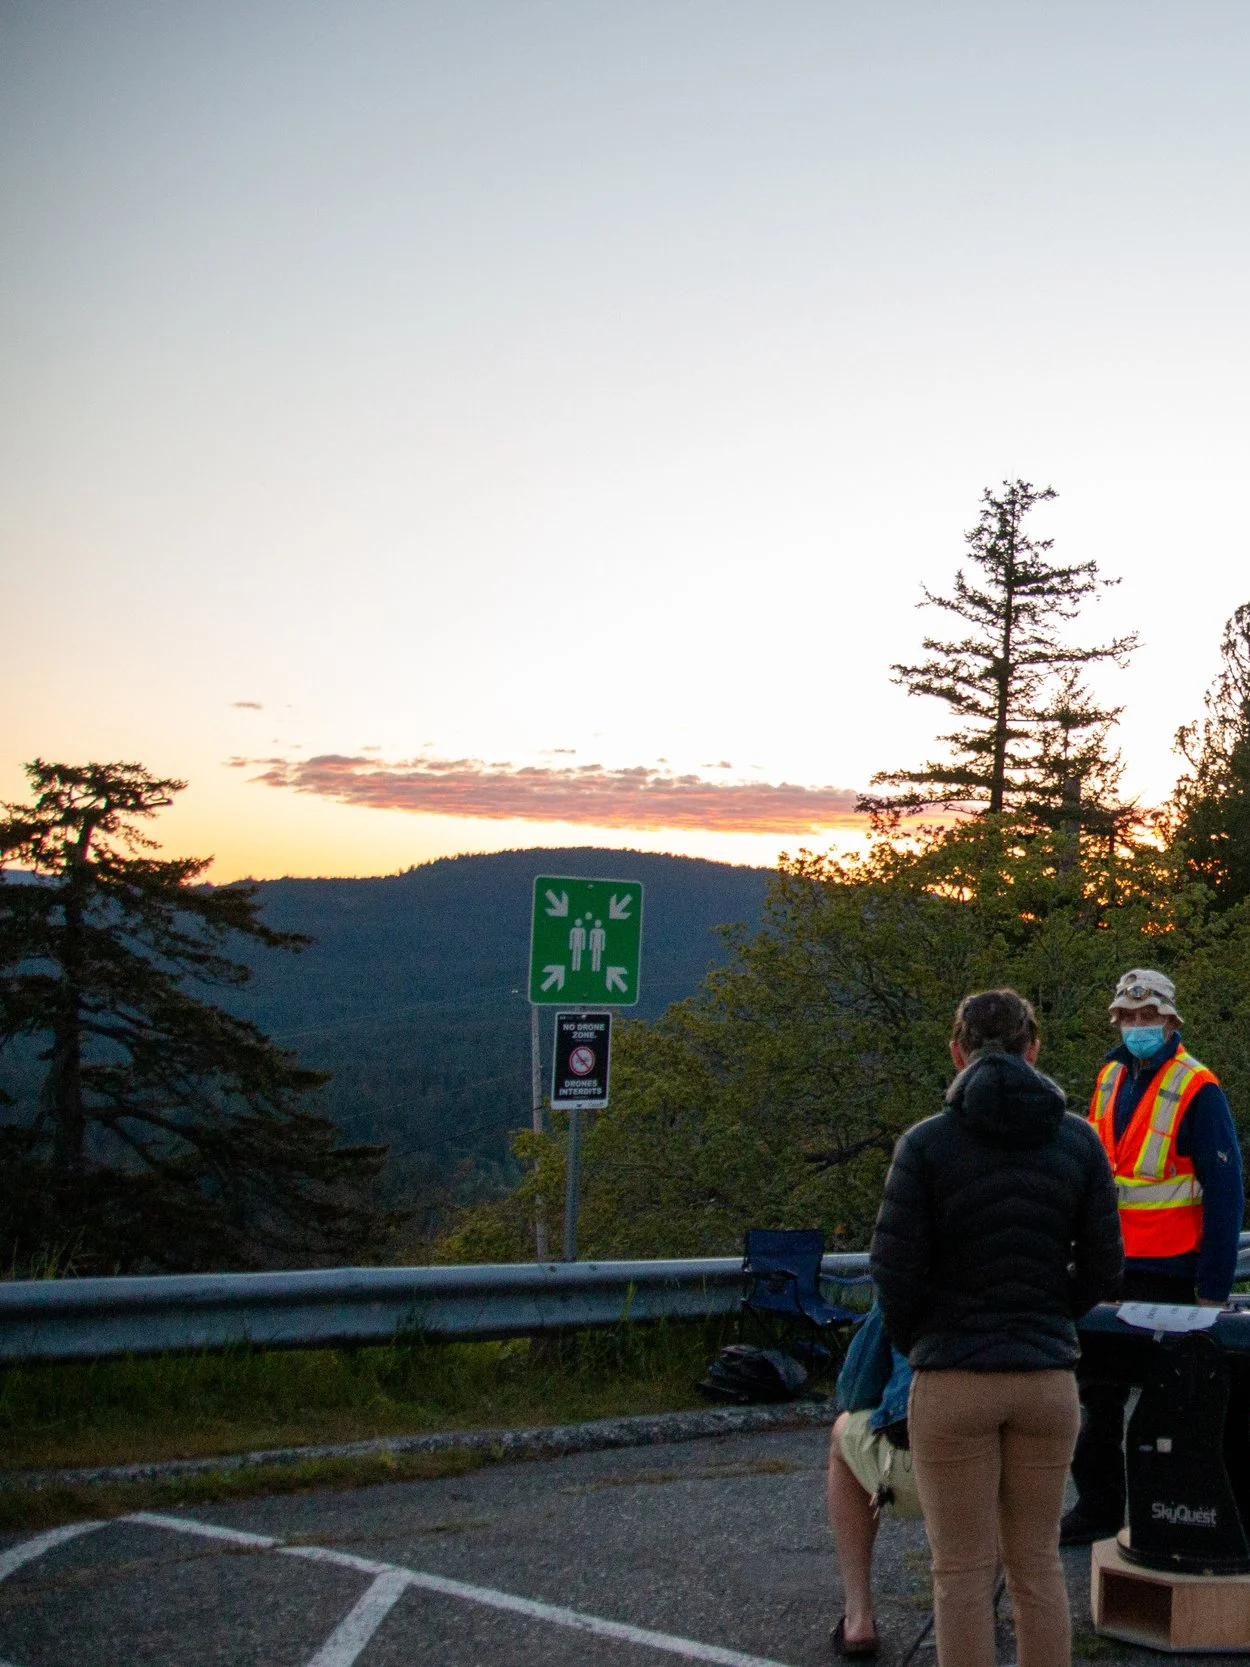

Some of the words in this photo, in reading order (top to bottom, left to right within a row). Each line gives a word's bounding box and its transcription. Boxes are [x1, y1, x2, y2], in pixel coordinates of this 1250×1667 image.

[562, 1023, 575, 1031] NO
[577, 1023, 605, 1031] DRONE
[559, 1088, 602, 1096] INTERDITS
[1151, 1502, 1217, 1524] SkyQuest
